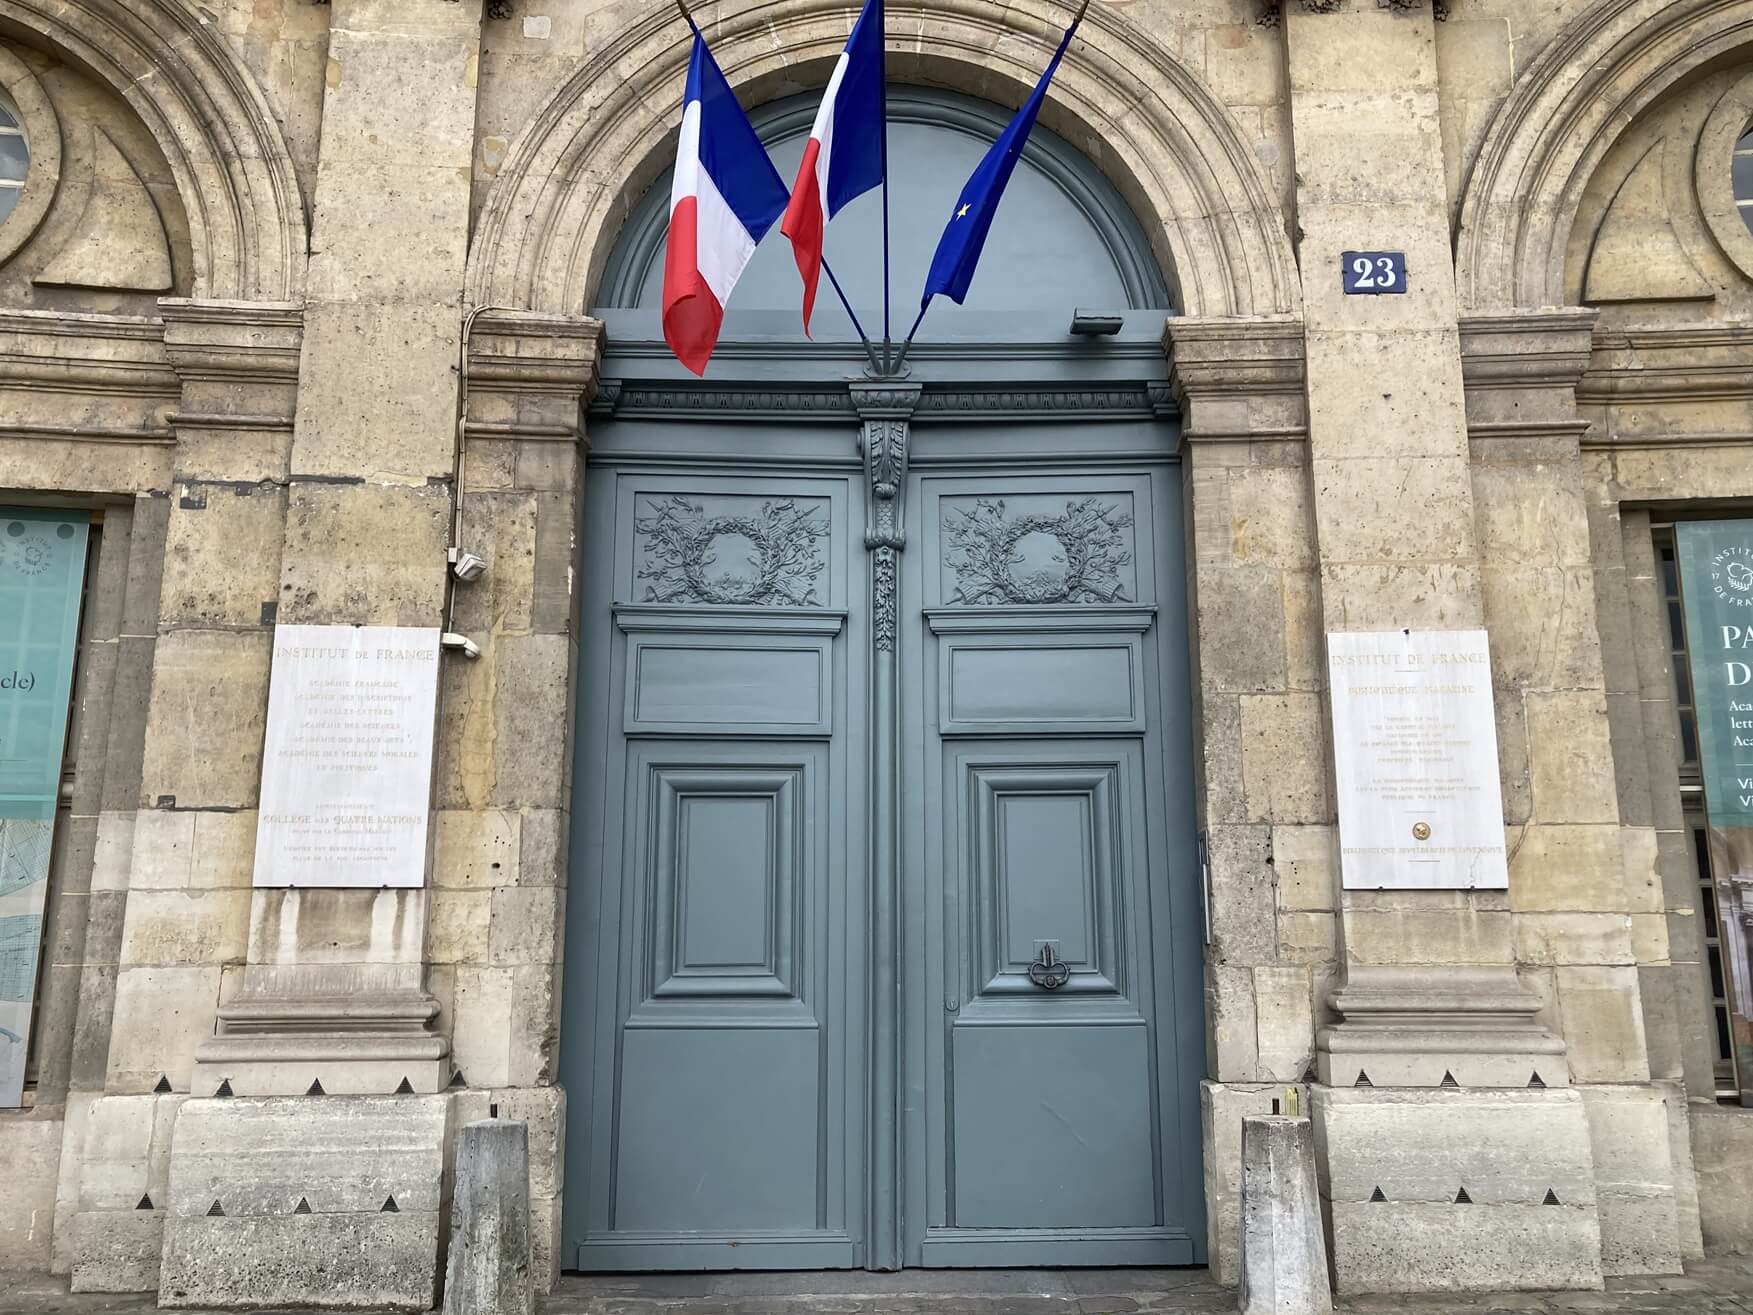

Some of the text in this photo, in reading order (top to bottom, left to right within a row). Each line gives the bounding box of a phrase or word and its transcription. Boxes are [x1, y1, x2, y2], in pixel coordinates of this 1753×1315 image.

[1353, 257, 1396, 288] 23
[1714, 585, 1753, 607] DE FRA
[276, 647, 435, 661] INSTITUT DE FRANCE
[1331, 653, 1487, 665] INSTITUT DE FRANCE
